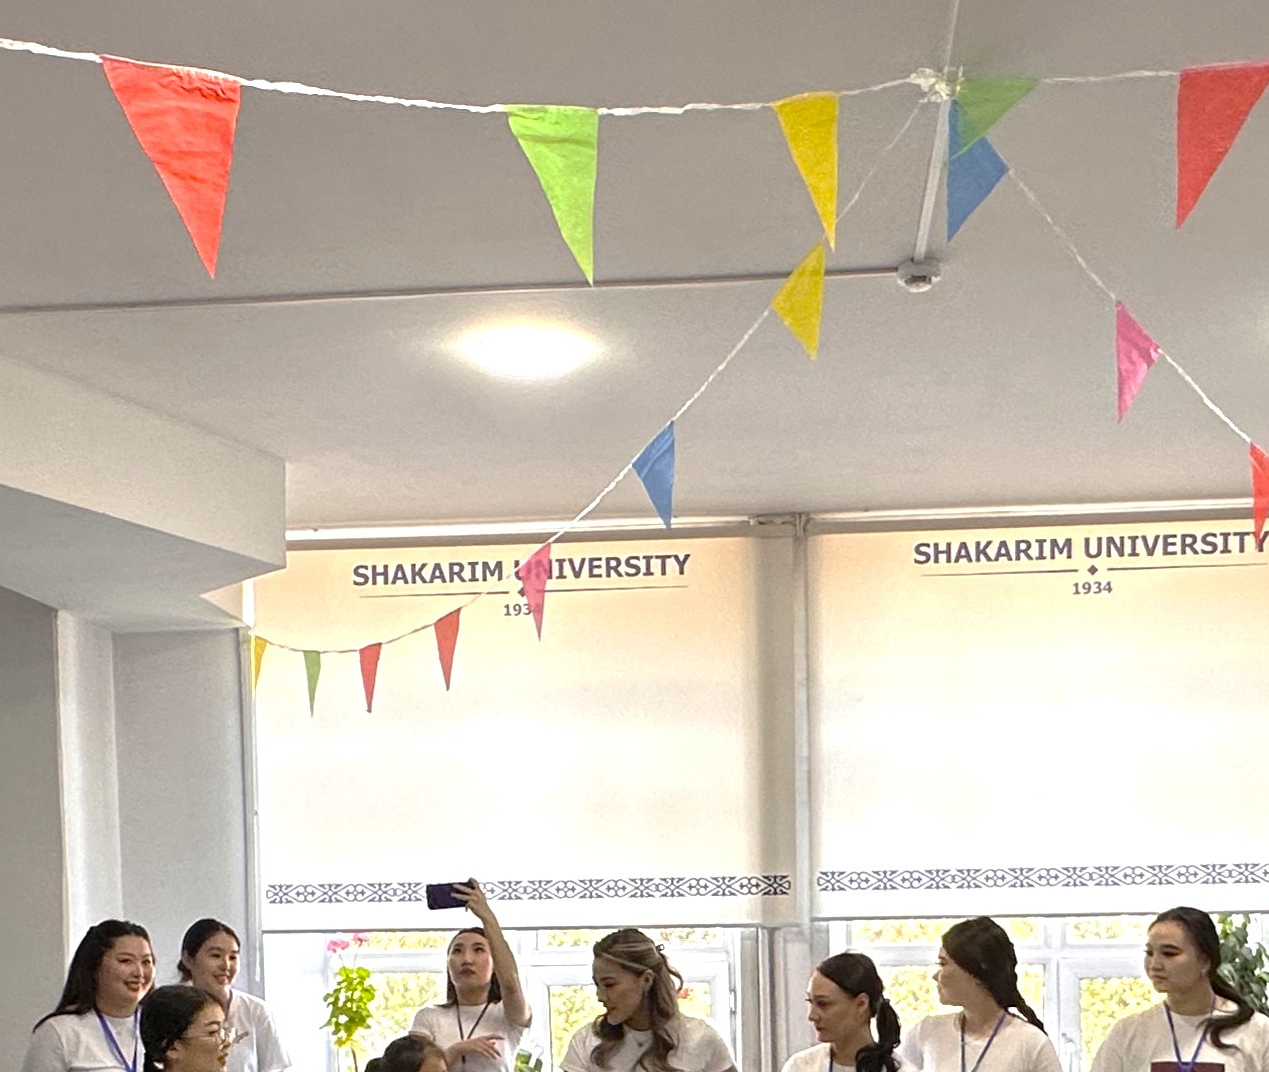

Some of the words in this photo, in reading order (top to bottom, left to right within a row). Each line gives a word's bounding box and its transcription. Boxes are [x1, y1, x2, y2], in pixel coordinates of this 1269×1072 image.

[913, 537, 1073, 565] SHAKARIM
[352, 560, 504, 586] SHAKARIM
[1072, 580, 1113, 595] 1934
[503, 603, 533, 616] 193
